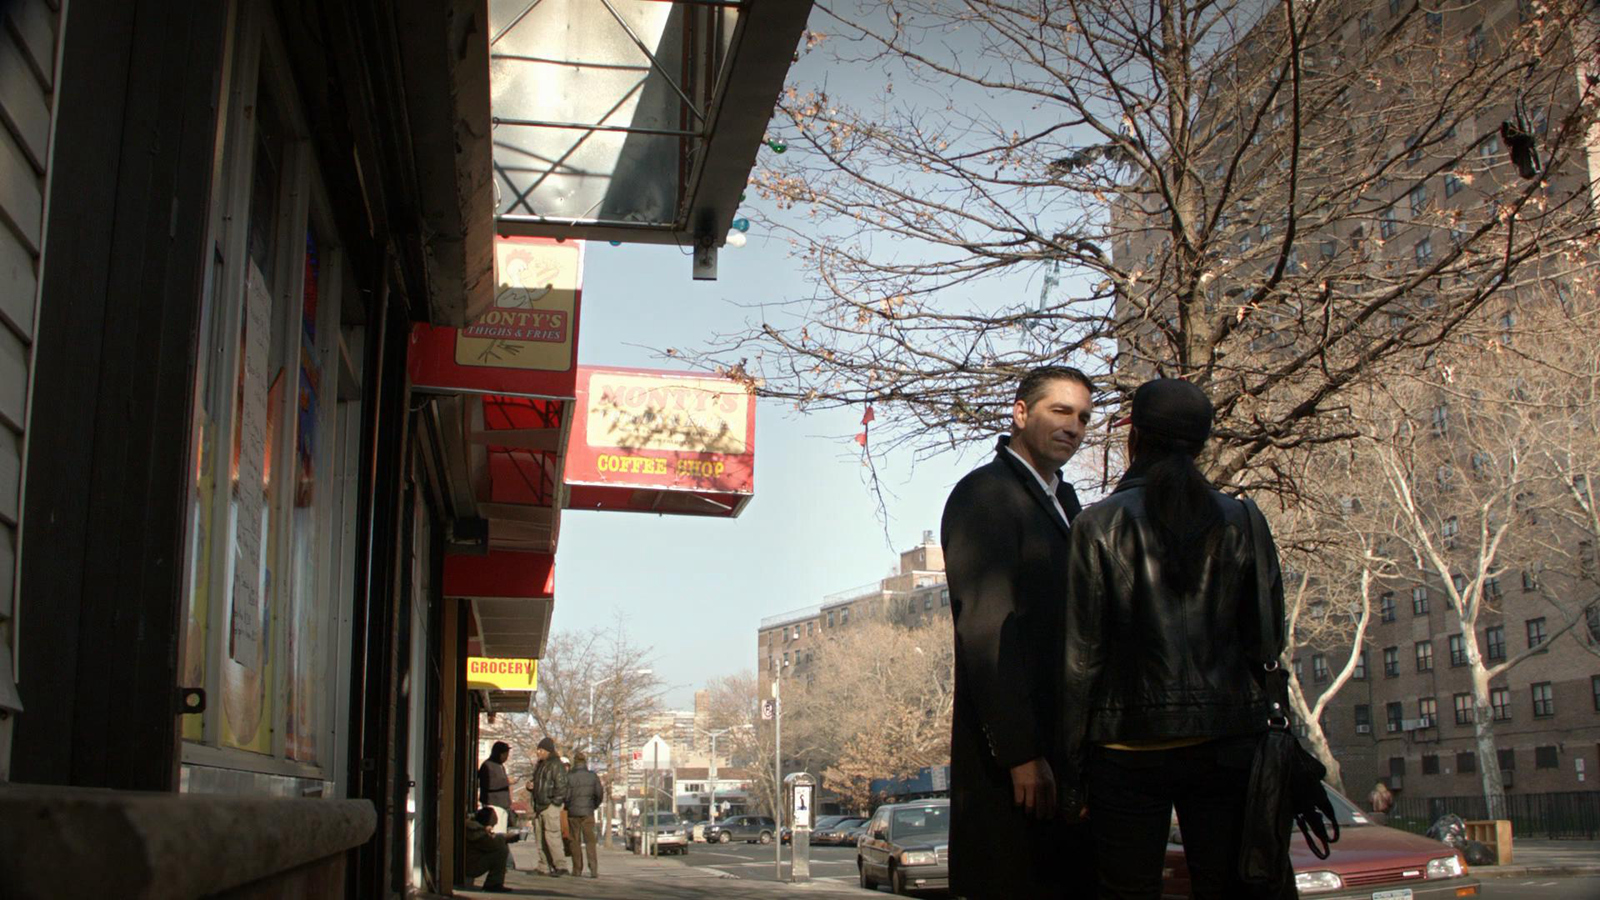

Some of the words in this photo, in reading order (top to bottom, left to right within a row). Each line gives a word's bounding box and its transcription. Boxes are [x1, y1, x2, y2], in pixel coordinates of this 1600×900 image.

[467, 326, 512, 337] THIGHS
[514, 329, 522, 338] &
[526, 329, 561, 340] FRIES
[600, 385, 738, 414] MONTYS
[598, 454, 667, 475] COFFEE
[677, 459, 724, 478] SHOP
[470, 661, 532, 674] GROCERY
